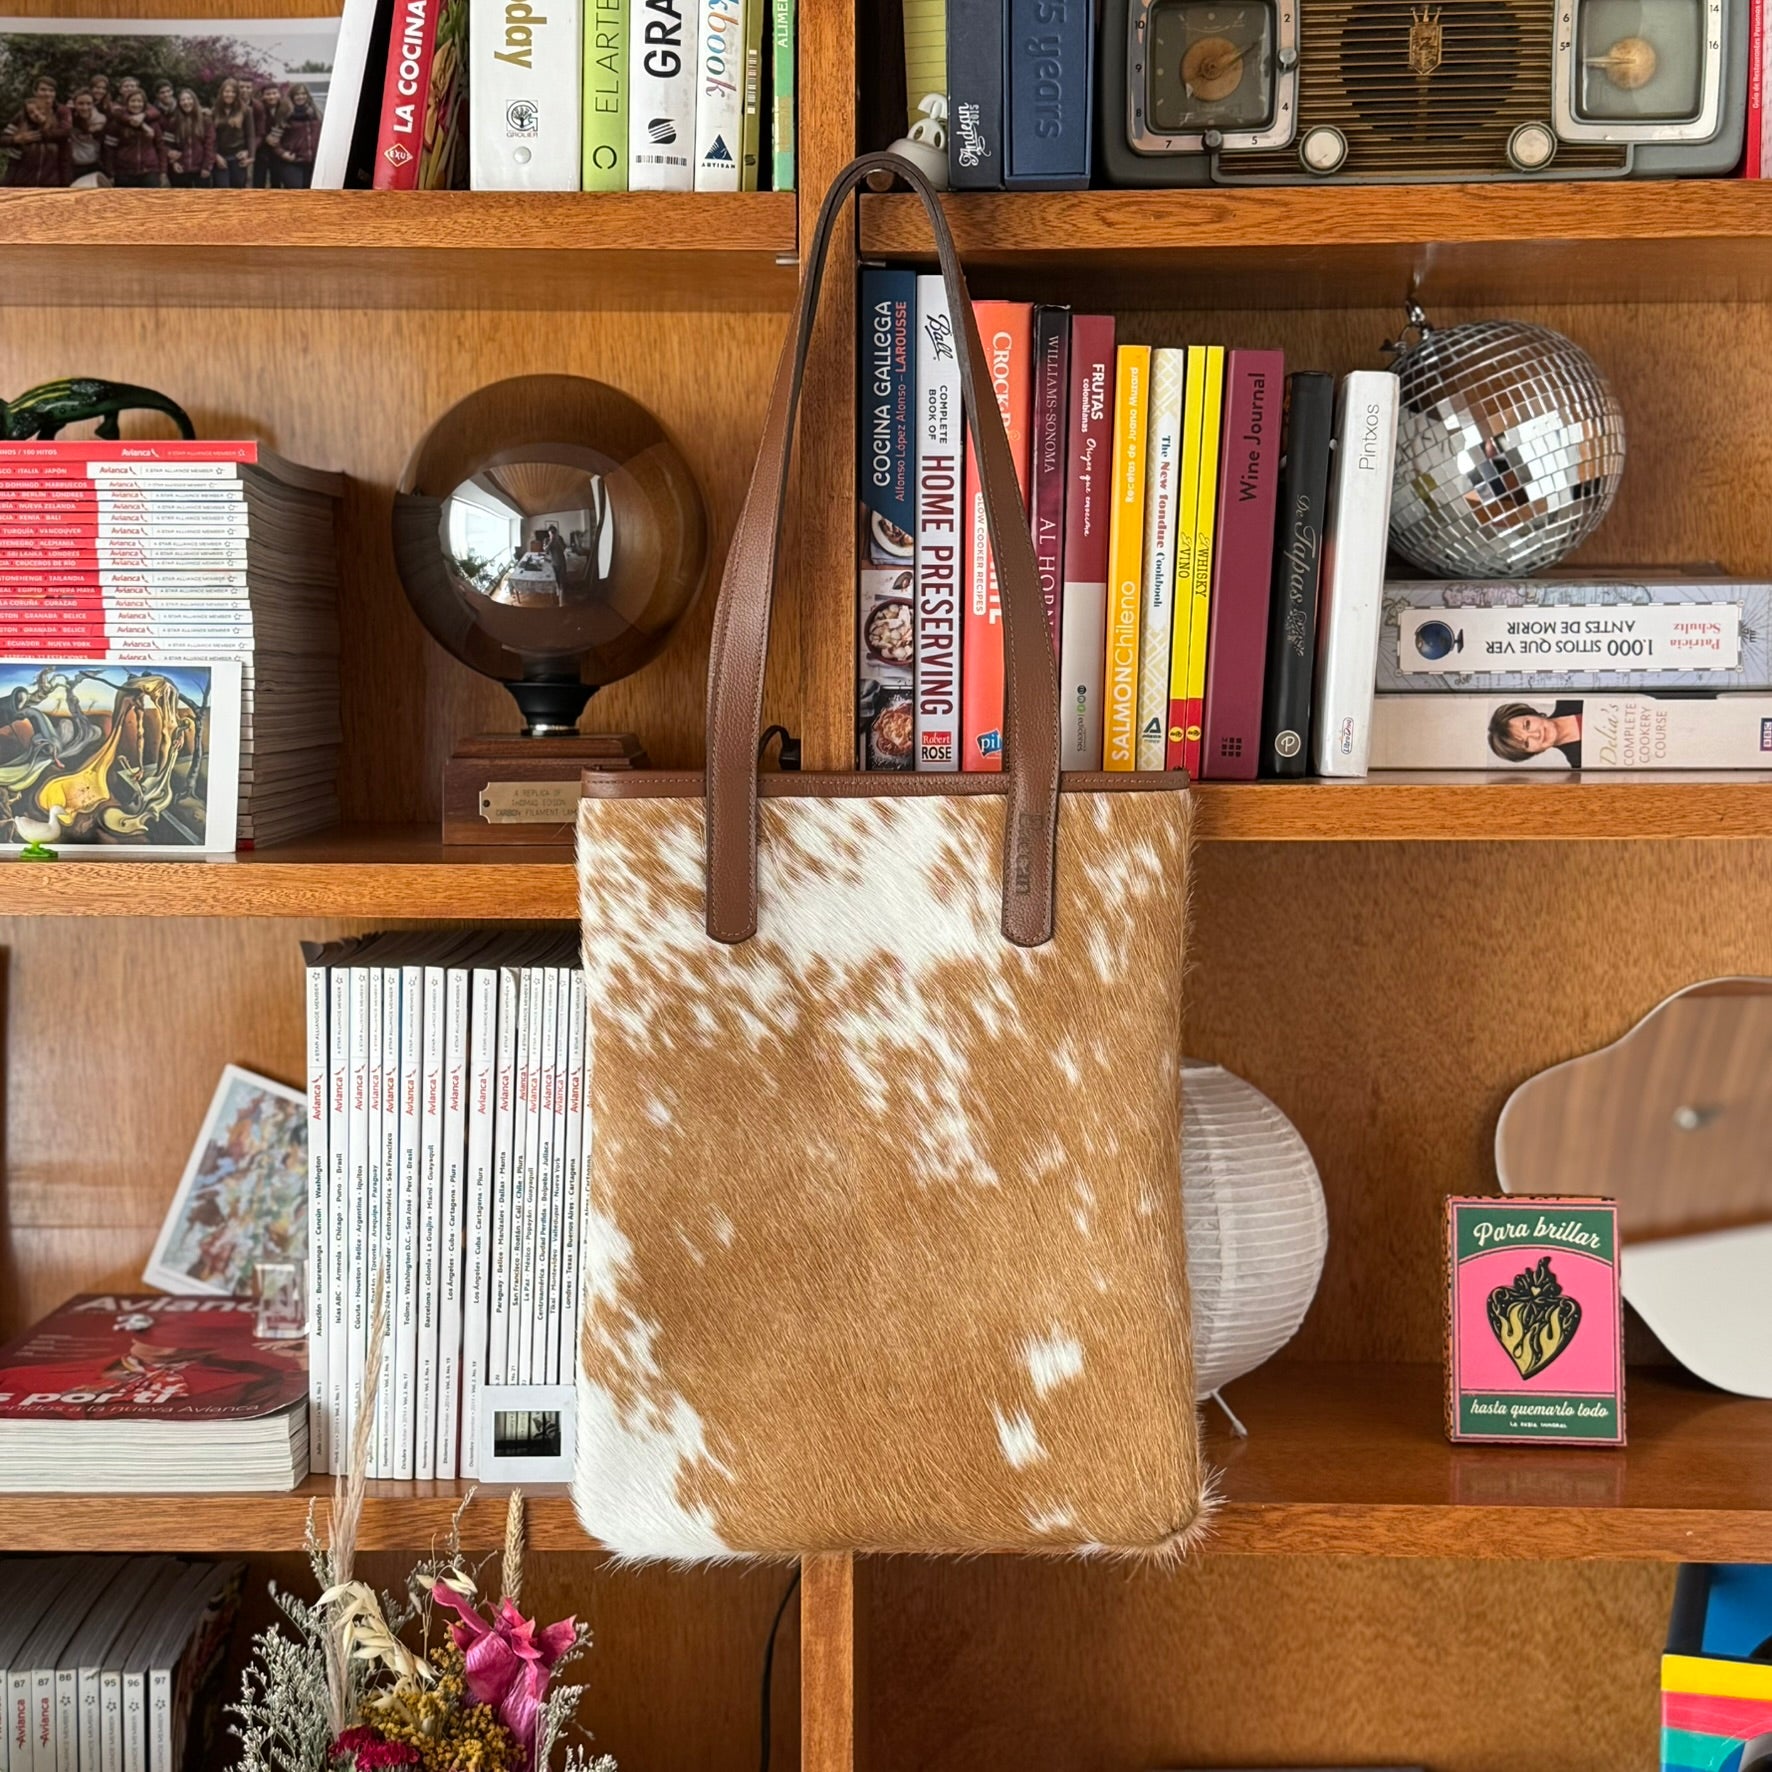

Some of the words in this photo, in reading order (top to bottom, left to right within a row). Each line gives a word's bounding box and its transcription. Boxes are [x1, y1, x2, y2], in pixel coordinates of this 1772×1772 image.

[777, 0, 789, 48] ALIME
[1135, 20, 1145, 30] 10
[1284, 14, 1291, 22] 2
[1562, 14, 1570, 22] 6
[1709, 4, 1720, 13] 14
[398, 0, 427, 95] COCINA
[494, 0, 547, 69] day
[596, 0, 620, 74] ARTE
[1709, 41, 1720, 50] 16
[1136, 64, 1142, 72] 9
[595, 79, 619, 113] EL
[1023, 34, 1063, 139] years
[393, 104, 415, 134] LA
[969, 104, 980, 125] 2015
[1136, 108, 1142, 118] 8
[1282, 102, 1288, 112] 4
[956, 102, 990, 167] Andean
[1166, 140, 1172, 149] 7
[1252, 136, 1258, 146] 5
[895, 301, 907, 372] LAROUSSE
[925, 314, 953, 361] Ball
[895, 385, 907, 421] Alonso
[928, 389, 937, 419] BOOK
[1044, 336, 1059, 473] WILLIAMS-SONOMA
[1081, 378, 1090, 432] colombianas
[1091, 364, 1104, 420] FRUTAS
[938, 385, 948, 444] COMPLETE
[1244, 373, 1265, 445] Journal
[872, 405, 892, 487] COCINA
[894, 424, 908, 457] López
[928, 424, 937, 440] OF
[1160, 435, 1172, 457] The
[1359, 404, 1379, 470] Pintxos
[1126, 445, 1136, 459] de
[894, 461, 907, 501] Alfonso
[1125, 462, 1136, 502] Recetas
[1159, 460, 1170, 491] New
[1239, 450, 1260, 501] Wine
[921, 455, 954, 533] HOME
[975, 495, 985, 525] SLOW
[1295, 495, 1310, 517] De
[1039, 518, 1057, 544] AL
[1156, 494, 1170, 548] fondue
[975, 527, 986, 568] COOKER
[1178, 549, 1191, 578] VINO
[1284, 522, 1316, 604] Tapas
[1152, 552, 1166, 608] Cookbook
[1194, 549, 1210, 597] WHISKY
[975, 571, 986, 613] RECIPES
[920, 545, 954, 715] PRESERVING
[1507, 621, 1559, 635] MORIR
[1561, 621, 1580, 634] DE
[1584, 620, 1636, 634] ANTES
[1672, 622, 1721, 634] Schultz
[1486, 641, 1515, 654] VER
[1520, 640, 1551, 654] QUE
[1555, 640, 1601, 653] SITIOS
[1608, 638, 1653, 655] 1.000
[1670, 638, 1720, 650] Patricia
[922, 733, 952, 744] Robert
[1598, 702, 1620, 767] Delia's
[1623, 702, 1637, 766] COMPLETE
[1639, 706, 1650, 764] COOKERY
[1655, 711, 1667, 758] COURSE
[922, 747, 952, 760] ROSE
[313, 1084, 322, 1120] Avianca
[334, 1077, 343, 1112] Avianca
[355, 1075, 364, 1110] Avianca
[406, 1080, 415, 1116] Avianca
[450, 1075, 459, 1111] Avianca
[500, 1076, 509, 1111] Avianca
[314, 1156, 322, 1198] Washington
[356, 1165, 364, 1190] Iquitos
[449, 1164, 457, 1183] Piura
[449, 1190, 458, 1226] Cartagena
[498, 1181, 506, 1203] Dallas
[335, 1212, 343, 1241] Chicago
[355, 1197, 363, 1232] Argentina
[1473, 1222, 1531, 1246] Para
[1533, 1216, 1600, 1249] brillar
[315, 1245, 323, 1294] Bucaramanga
[446, 1258, 455, 1287] Ángeles
[496, 1280, 505, 1313] Paraguay
[19, 1391, 122, 1406] por
[179, 1405, 259, 1413] Avianca
[1471, 1399, 1507, 1415] hasta
[1510, 1401, 1575, 1418] quemarlo
[1577, 1402, 1608, 1417] todo
[14, 1680, 25, 1688] 87
[38, 1678, 49, 1686] 87
[59, 1673, 72, 1681] 88
[104, 1679, 116, 1687] 95
[127, 1679, 140, 1687] 96
[154, 1677, 166, 1685] 97
[16, 1699, 26, 1745] Avianca
[40, 1697, 50, 1742] Avianca
